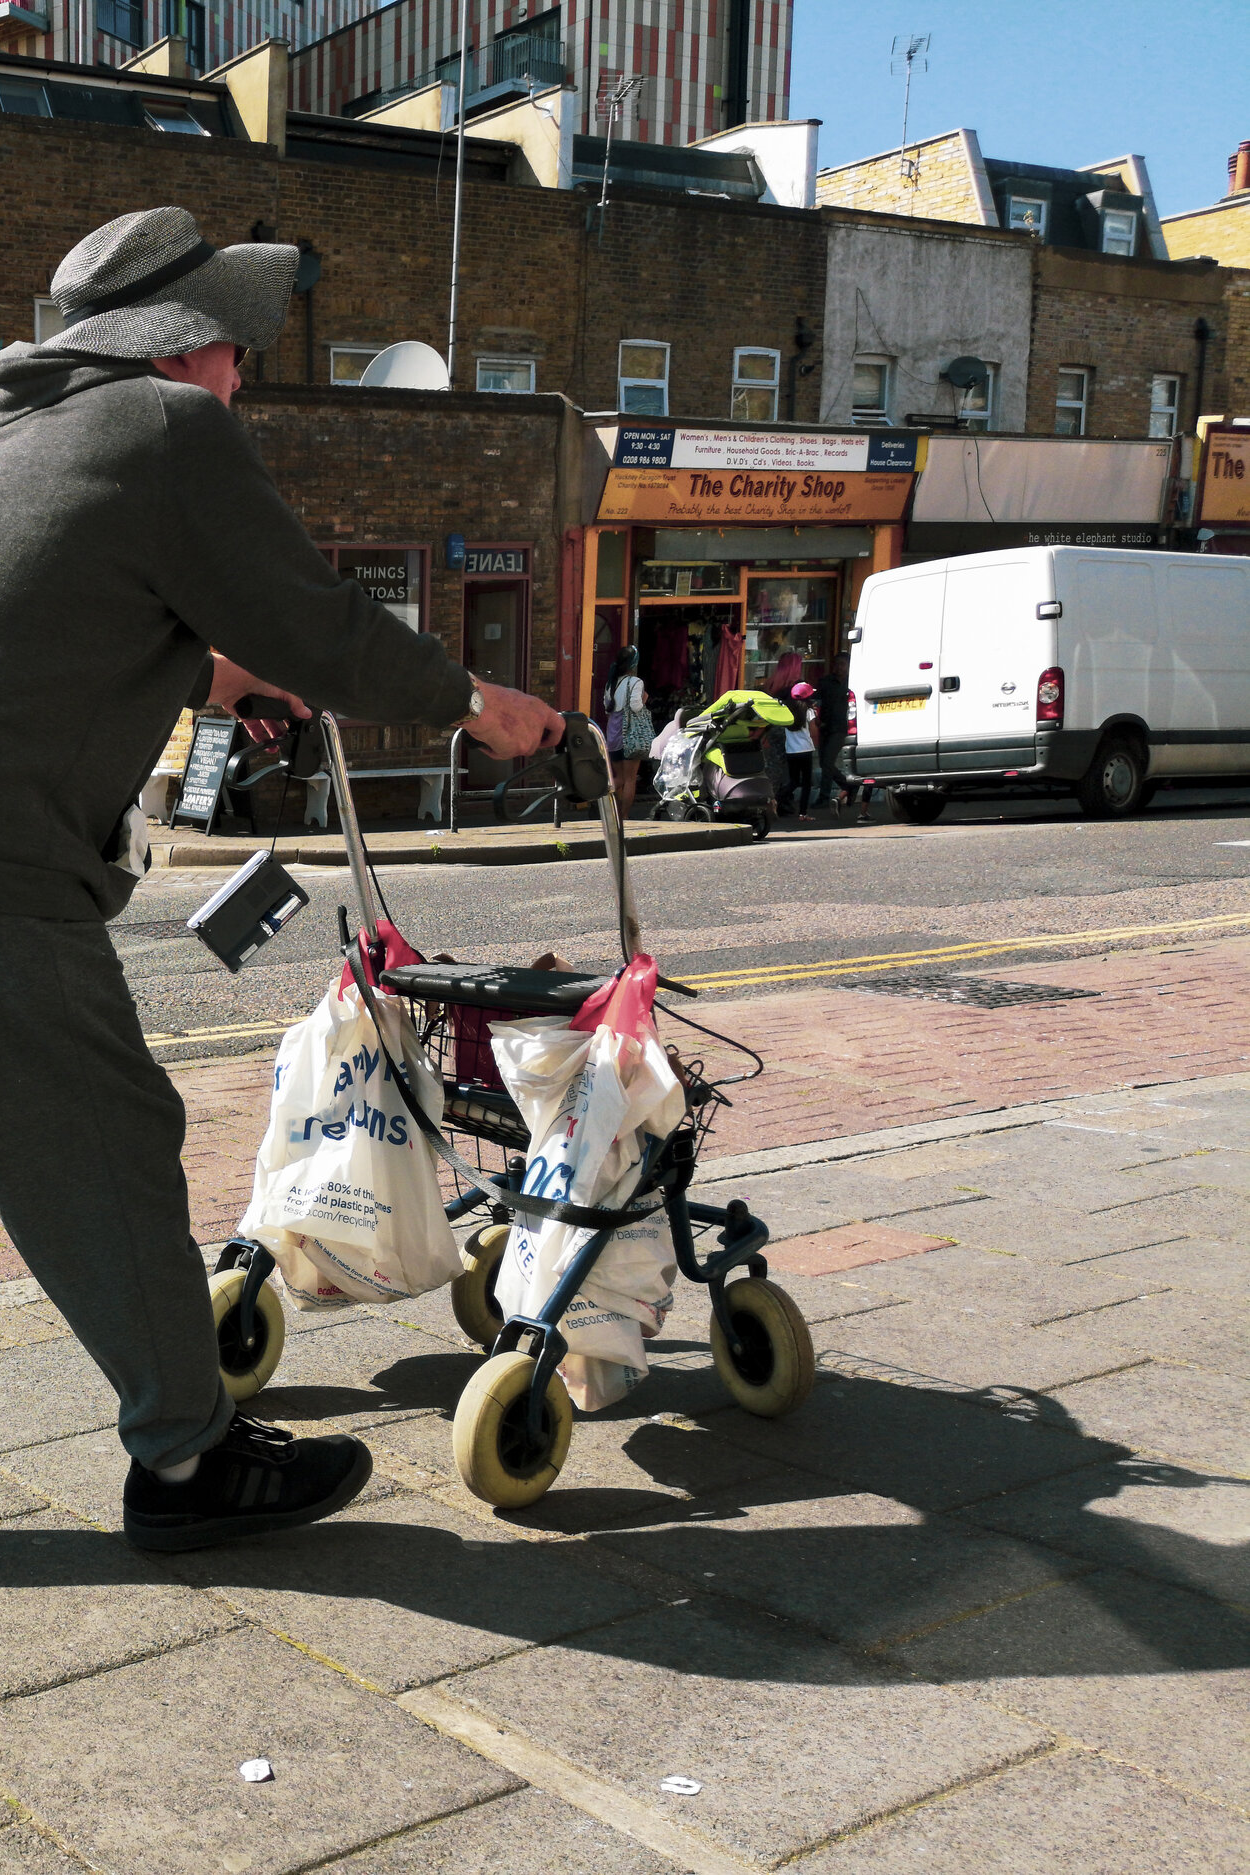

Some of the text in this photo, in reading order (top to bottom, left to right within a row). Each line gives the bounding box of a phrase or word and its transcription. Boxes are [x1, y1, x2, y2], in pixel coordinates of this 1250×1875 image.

[623, 432, 640, 440] OPEN
[641, 432, 656, 441] MON
[660, 433, 671, 441] SAT
[680, 433, 709, 441] Women's
[738, 435, 769, 443] Children's
[770, 436, 795, 446] Clothing
[800, 436, 817, 445] Shoes
[822, 437, 837, 446] Bags
[841, 438, 854, 446] Hats
[694, 445, 722, 454] Furniture
[726, 446, 759, 455] Household
[760, 447, 781, 455] Goods
[824, 448, 848, 457] Records
[881, 441, 905, 449] Deliveries
[771, 459, 792, 467] Videos
[870, 459, 912, 467] House Clearance
[1211, 451, 1245, 479] The
[689, 474, 845, 502] The Charity Shop
[668, 503, 702, 518] Probably
[706, 504, 721, 515] the
[724, 504, 743, 515] best
[745, 503, 774, 518] Charity
[776, 503, 796, 517] Shop
[809, 504, 823, 515] the
[1044, 531, 1071, 544] white
[1075, 531, 1117, 546] elephant
[1121, 531, 1152, 544] studio
[354, 566, 406, 580] THINGS
[369, 586, 414, 600] TOAST
[289, 1185, 302, 1196] At
[327, 1181, 352, 1196] 80%
[353, 1187, 362, 1199] of
[374, 1201, 393, 1214] omes
[330, 1197, 362, 1213] plastic
[337, 1259, 352, 1272] made
[350, 1268, 364, 1279] from
[565, 1311, 631, 1330] tesco.com/r
